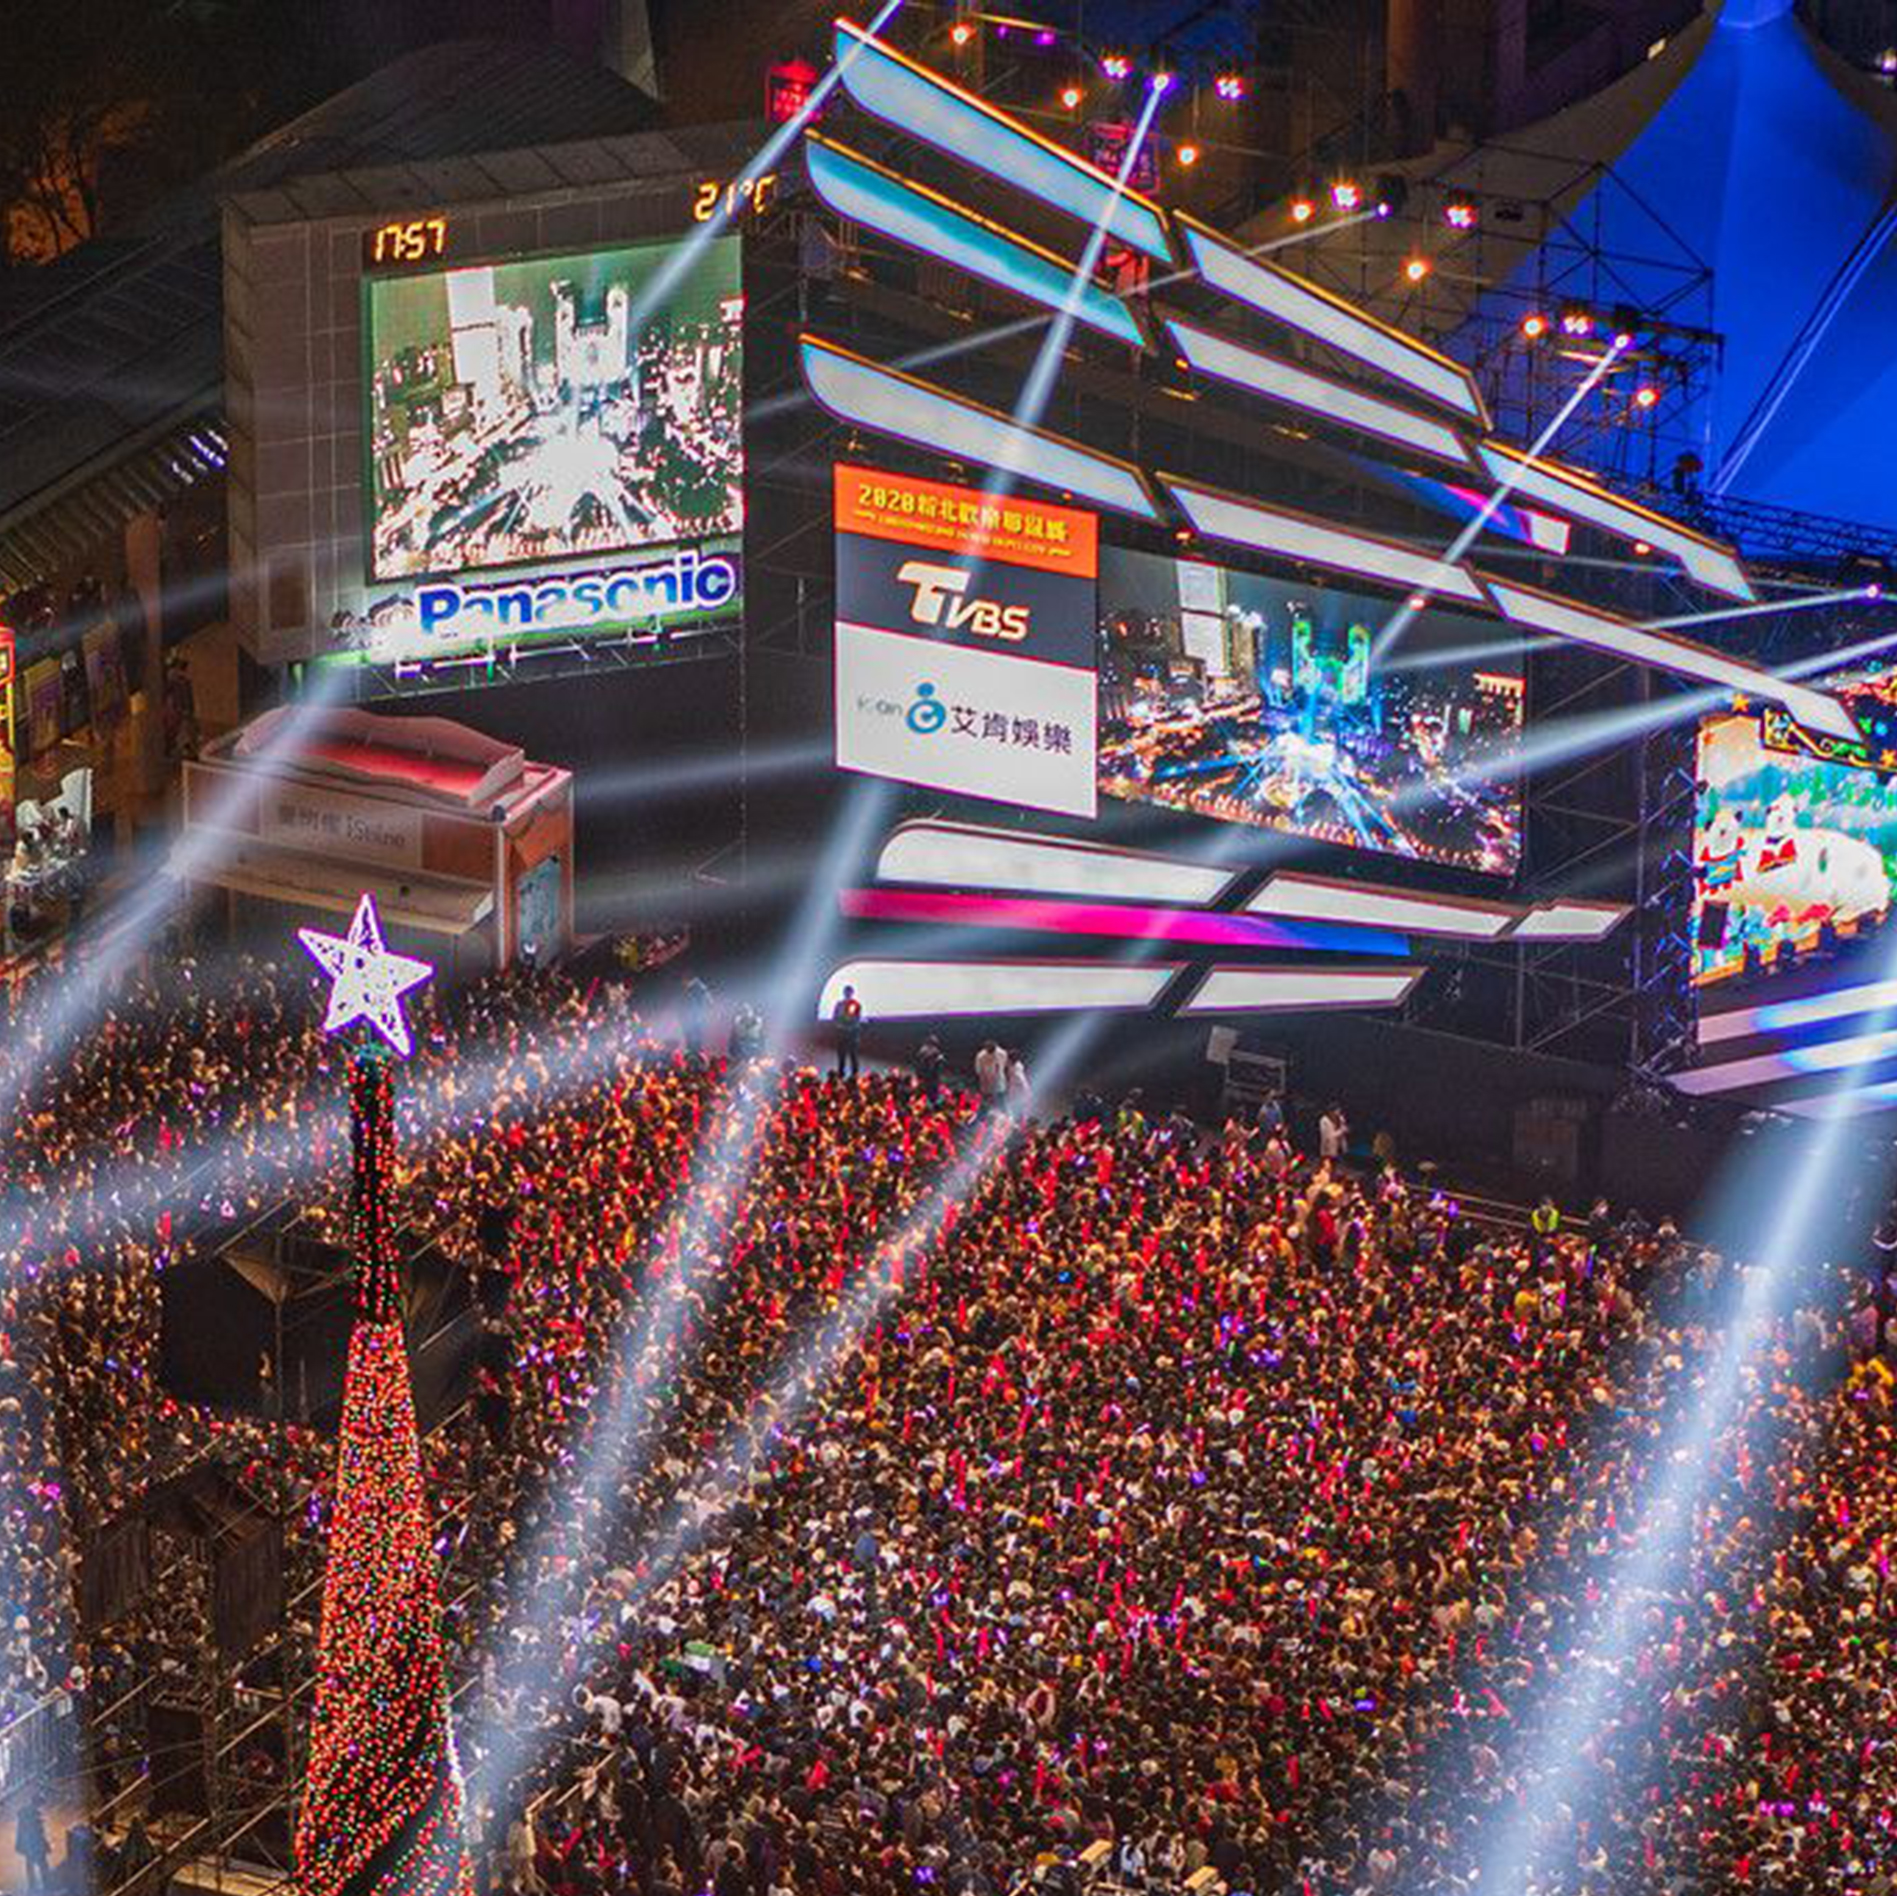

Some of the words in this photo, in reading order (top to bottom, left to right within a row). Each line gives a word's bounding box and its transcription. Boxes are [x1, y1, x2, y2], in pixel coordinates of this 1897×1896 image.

[374, 218, 446, 261] 17:57
[415, 550, 735, 638] Panasonic
[896, 560, 1030, 640] TVBS
[951, 705, 1072, 755] 艾肯娛樂
